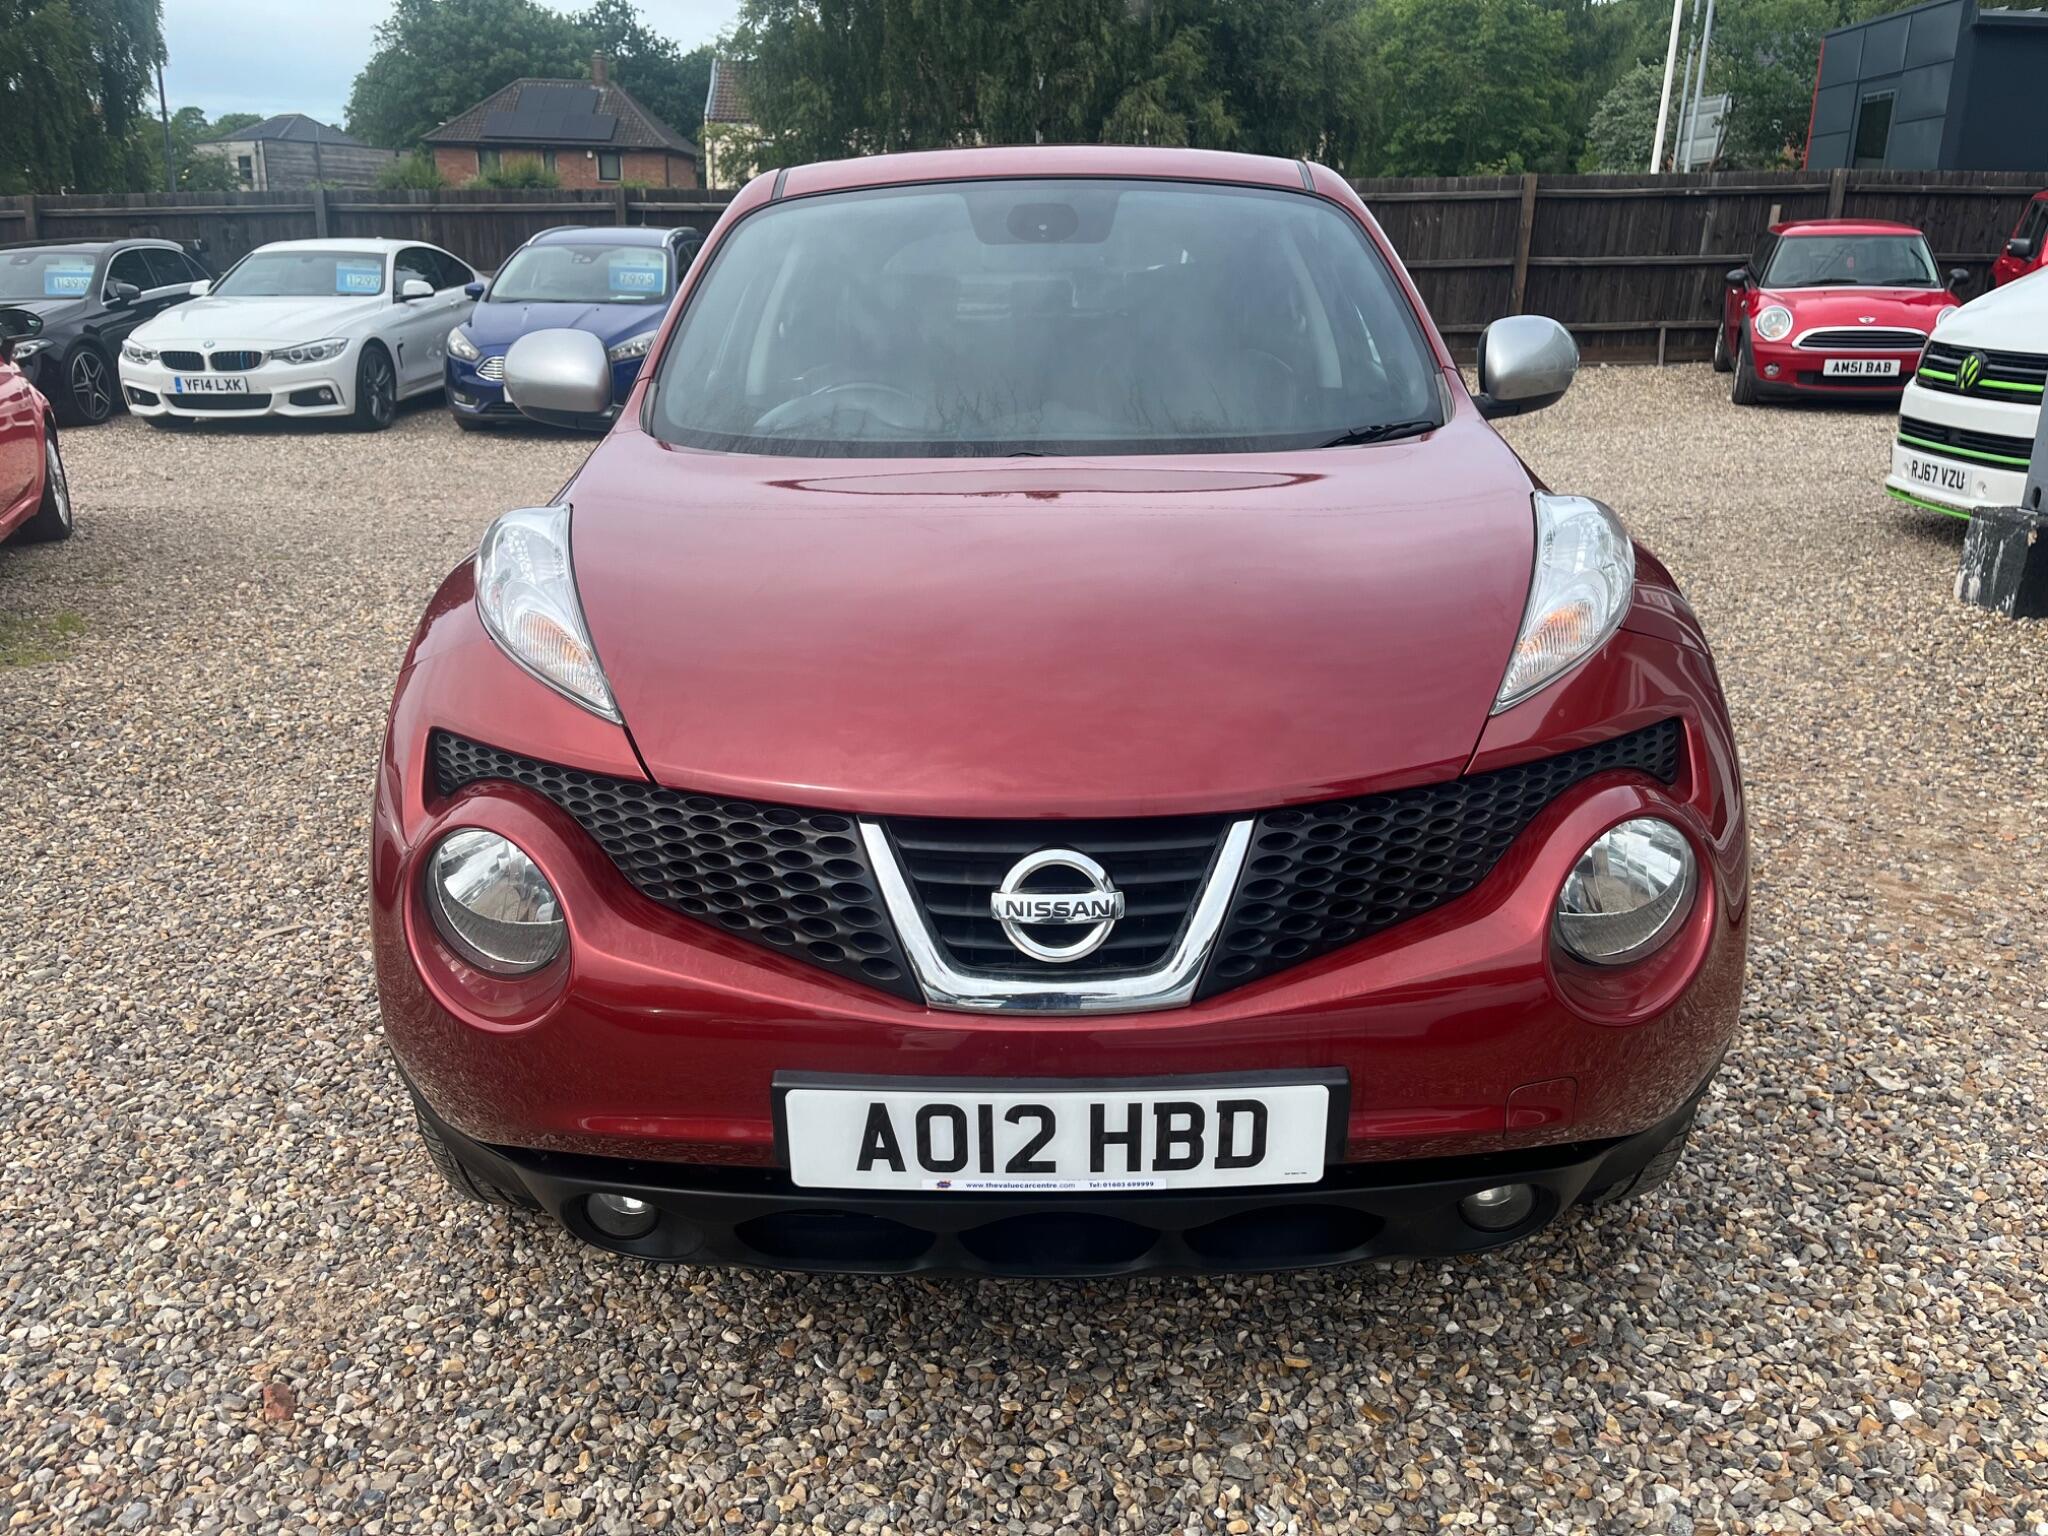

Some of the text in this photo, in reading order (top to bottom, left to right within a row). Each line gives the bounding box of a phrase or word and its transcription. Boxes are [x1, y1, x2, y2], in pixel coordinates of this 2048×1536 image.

[1832, 362, 1891, 373] AM51 BAB
[185, 378, 242, 391] YF14 LXK
[1911, 459, 1965, 490] RJ67 VZU
[1005, 899, 1111, 918] NISSAN
[856, 1099, 1268, 1173] AO12 HBD
